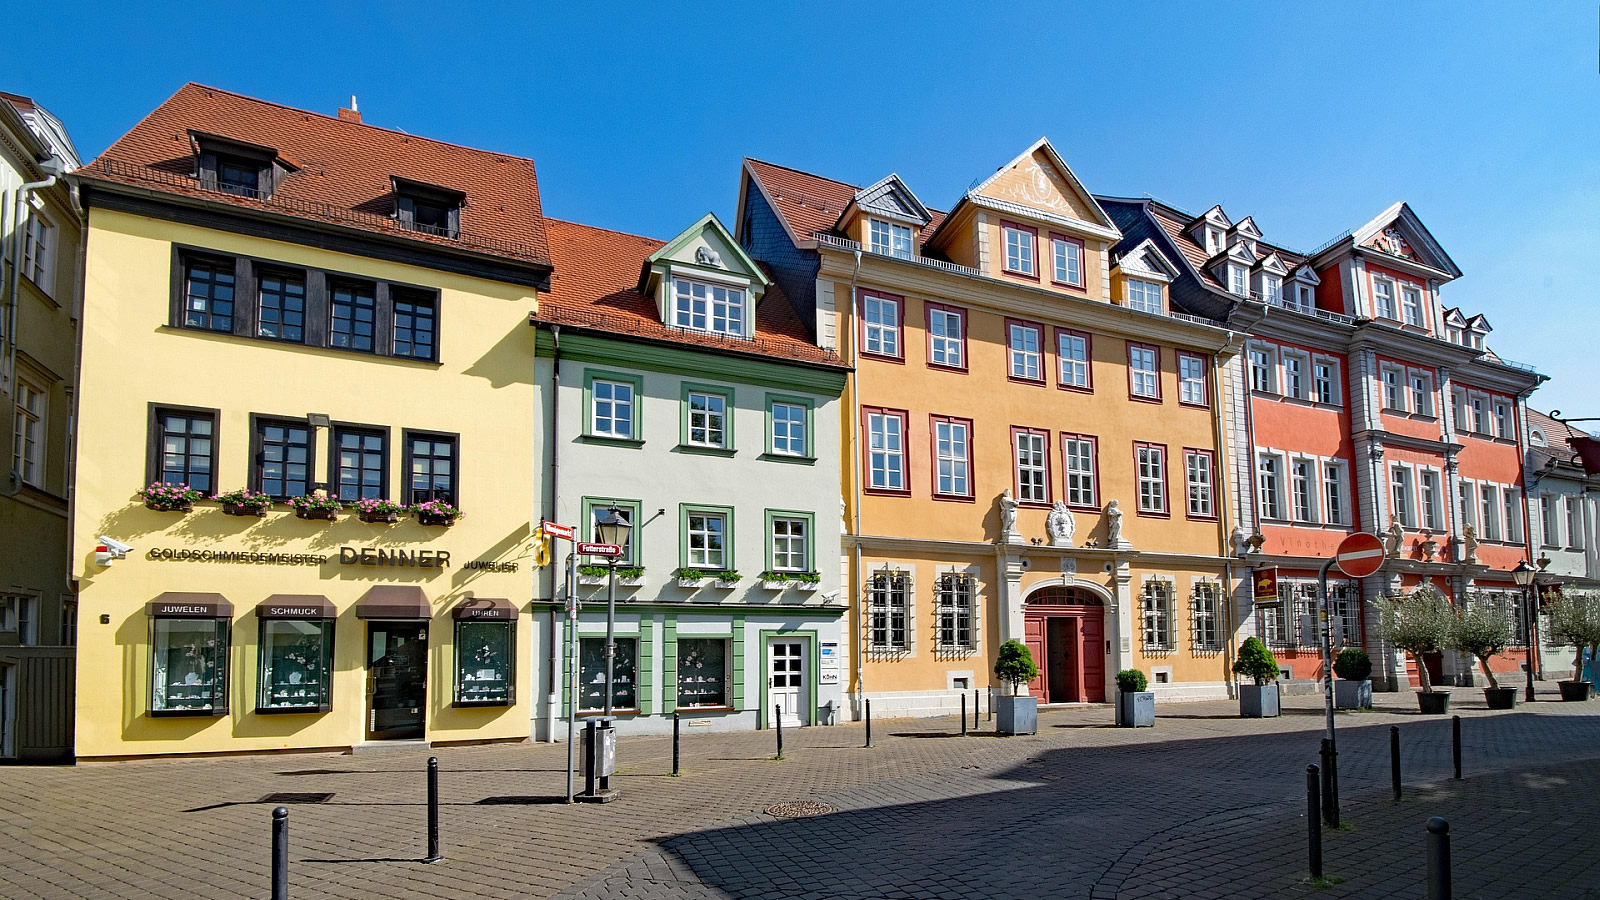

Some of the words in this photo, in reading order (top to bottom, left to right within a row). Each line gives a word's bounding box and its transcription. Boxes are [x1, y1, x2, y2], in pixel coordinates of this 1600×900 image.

[1280, 536, 1335, 550] Vinothe
[582, 545, 616, 553] Futterstraße
[150, 547, 327, 564] GOLDSCHMIEDEMEISTER
[339, 546, 451, 568] DENNER
[464, 560, 519, 571] JUWELIER
[162, 605, 207, 613] JUWELEN
[271, 607, 317, 615] SCHMUCK
[100, 614, 110, 624] 6
